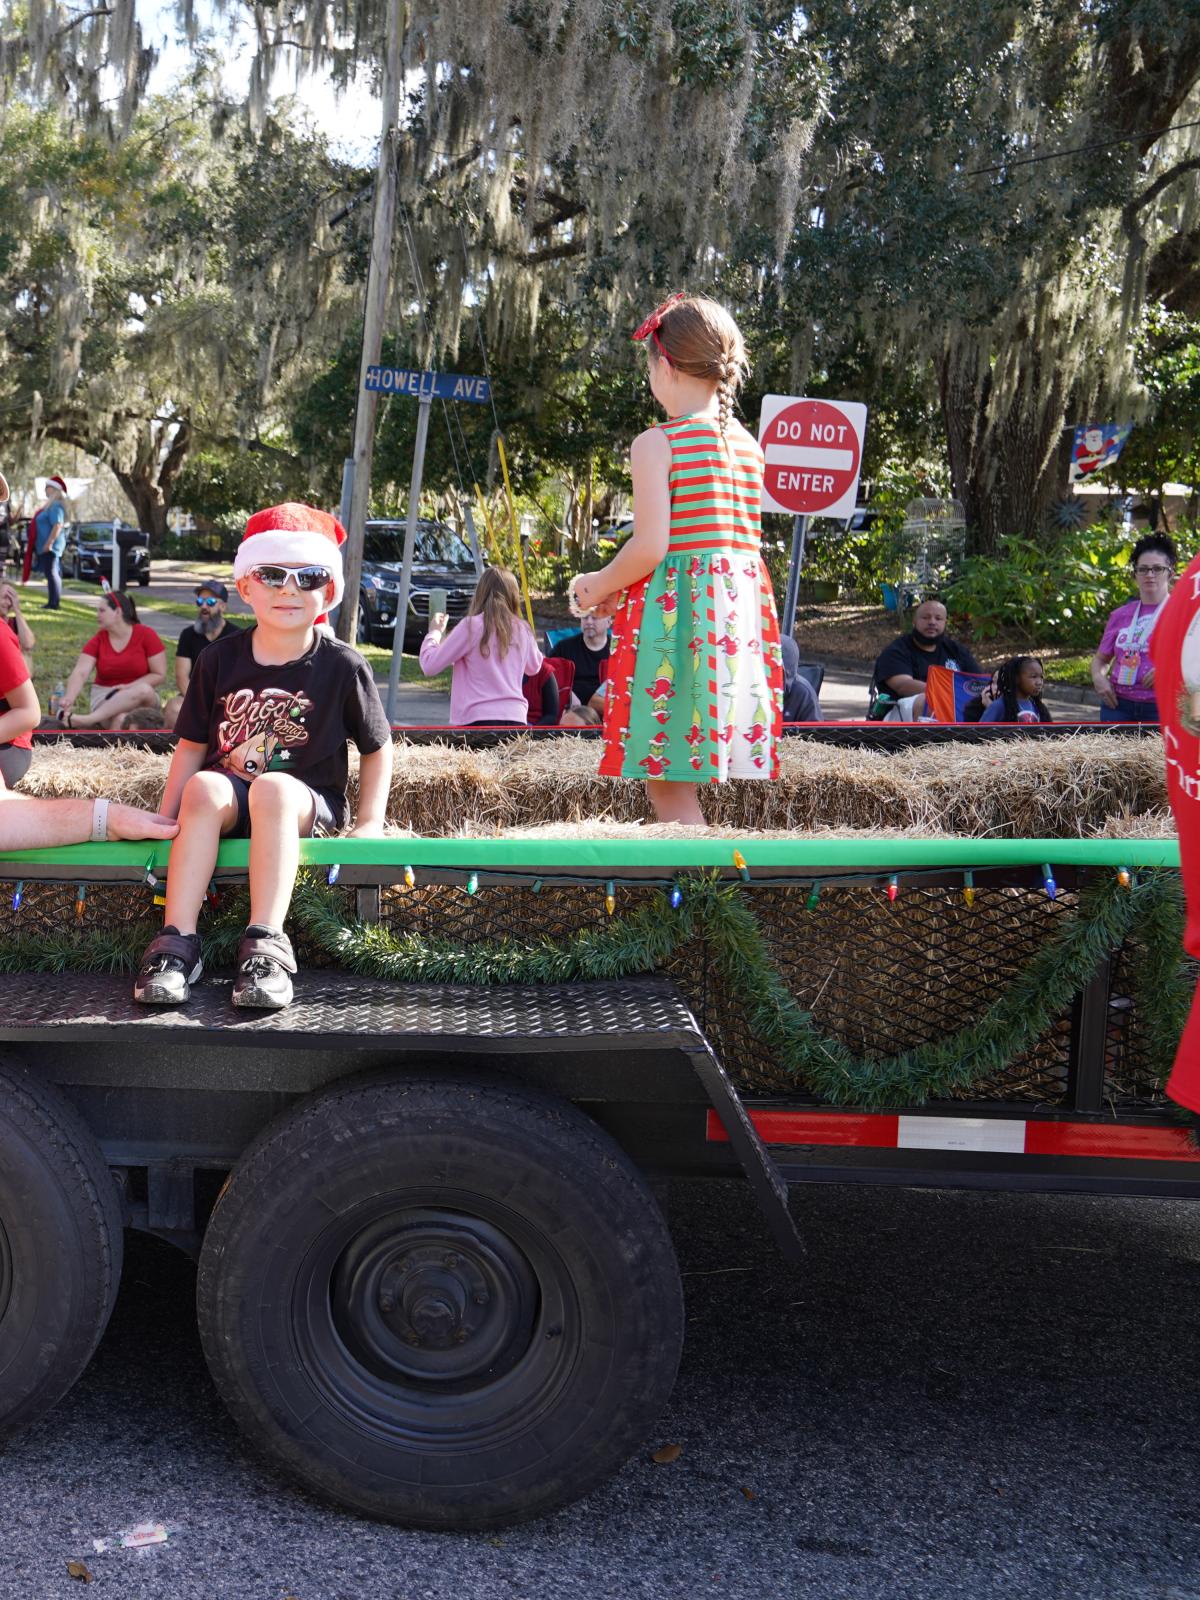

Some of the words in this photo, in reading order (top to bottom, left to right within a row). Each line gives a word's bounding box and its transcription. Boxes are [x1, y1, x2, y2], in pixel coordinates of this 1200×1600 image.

[368, 369, 441, 394] HOWELL
[453, 378, 487, 400] AVE
[776, 420, 802, 440] DO
[810, 423, 848, 443] NOT
[776, 471, 835, 493] ENTER
